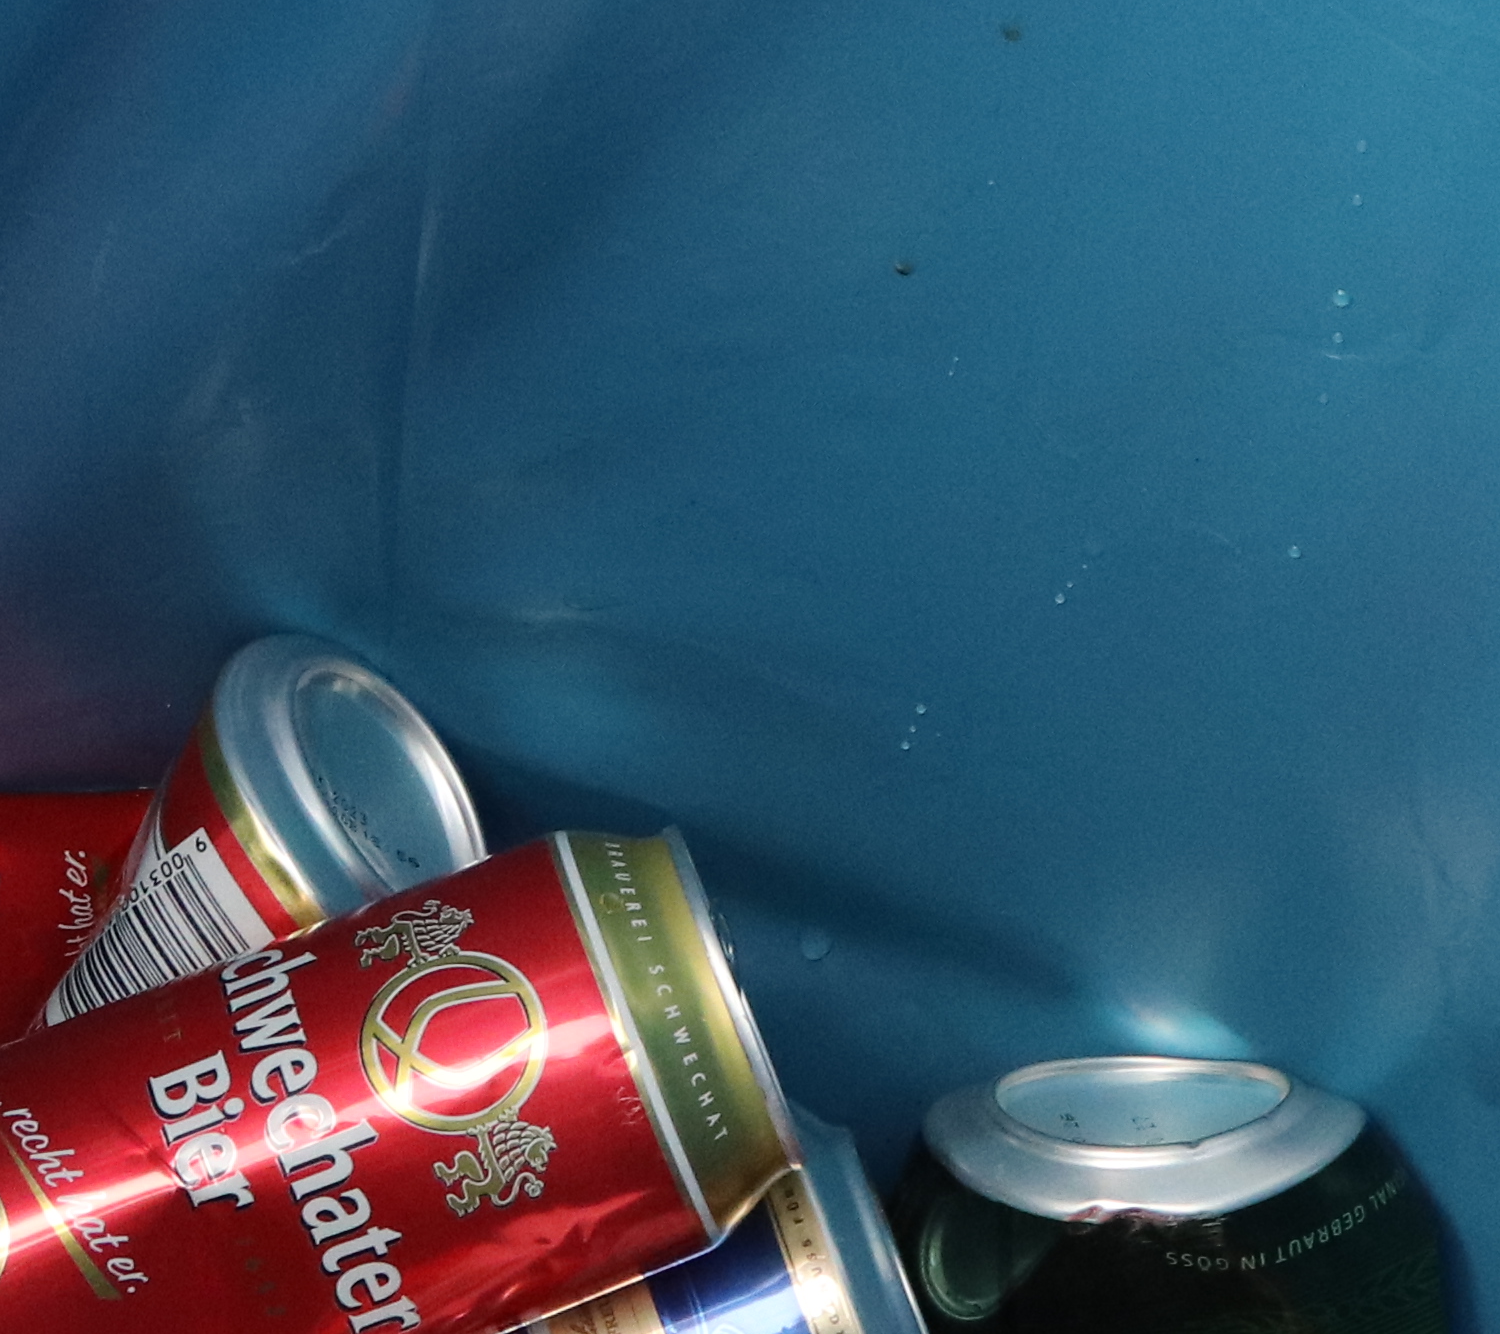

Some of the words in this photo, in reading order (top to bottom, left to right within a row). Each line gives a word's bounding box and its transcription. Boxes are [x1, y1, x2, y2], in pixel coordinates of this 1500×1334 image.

[647, 964, 729, 1144] SCHWECHAT
[148, 1050, 256, 1208] Bier
[56, 1190, 108, 1256] hat
[105, 1256, 151, 1296] er.
[1240, 1251, 1267, 1271] IN
[1275, 1204, 1369, 1265] GEBRAUT
